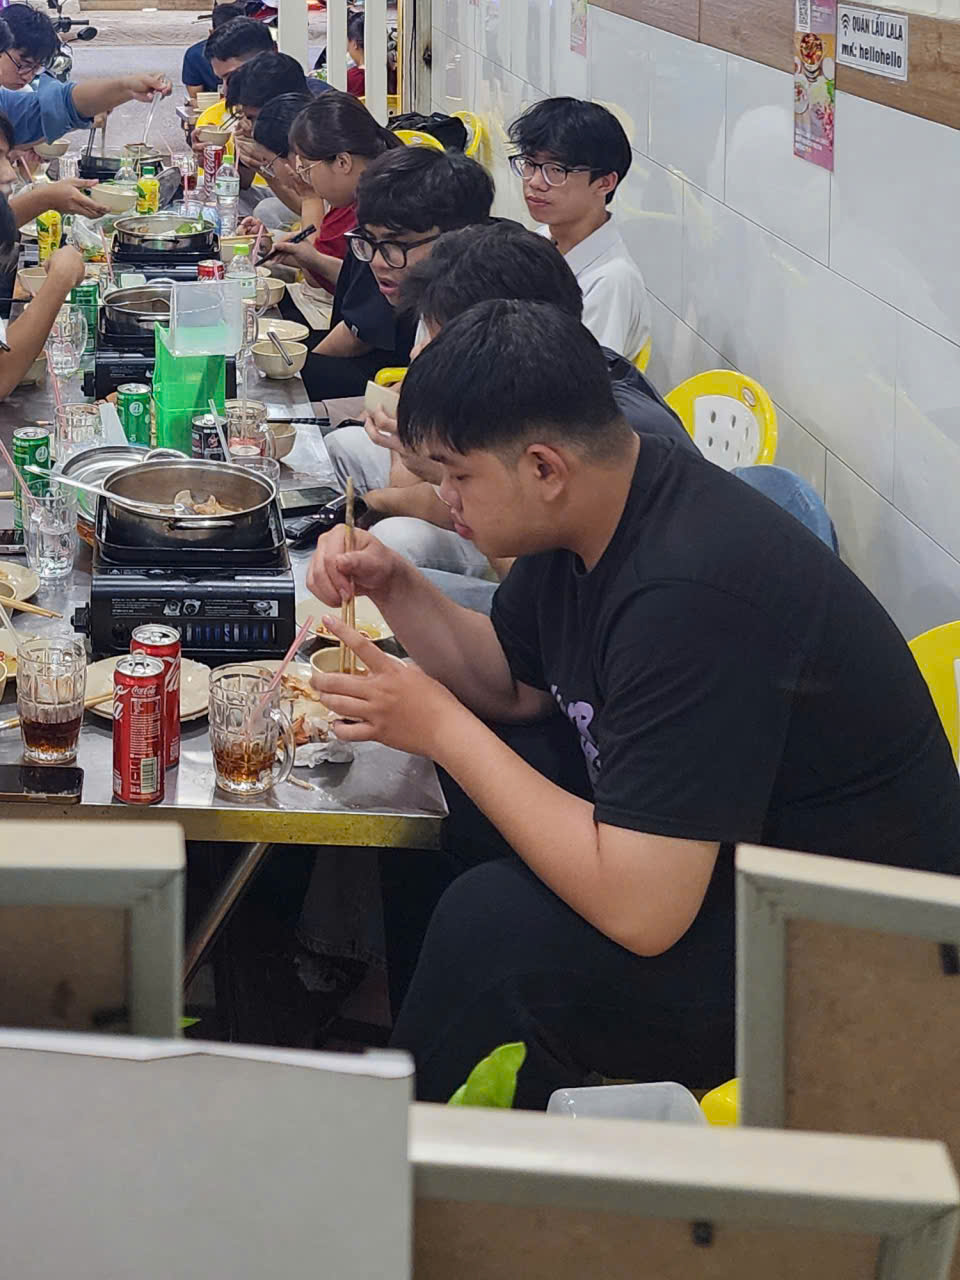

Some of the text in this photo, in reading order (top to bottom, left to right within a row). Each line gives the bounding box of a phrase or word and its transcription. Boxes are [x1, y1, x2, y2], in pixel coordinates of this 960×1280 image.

[852, 14, 870, 37] QUÁN
[886, 22, 903, 41] LALA
[859, 42, 902, 69] hellohello
